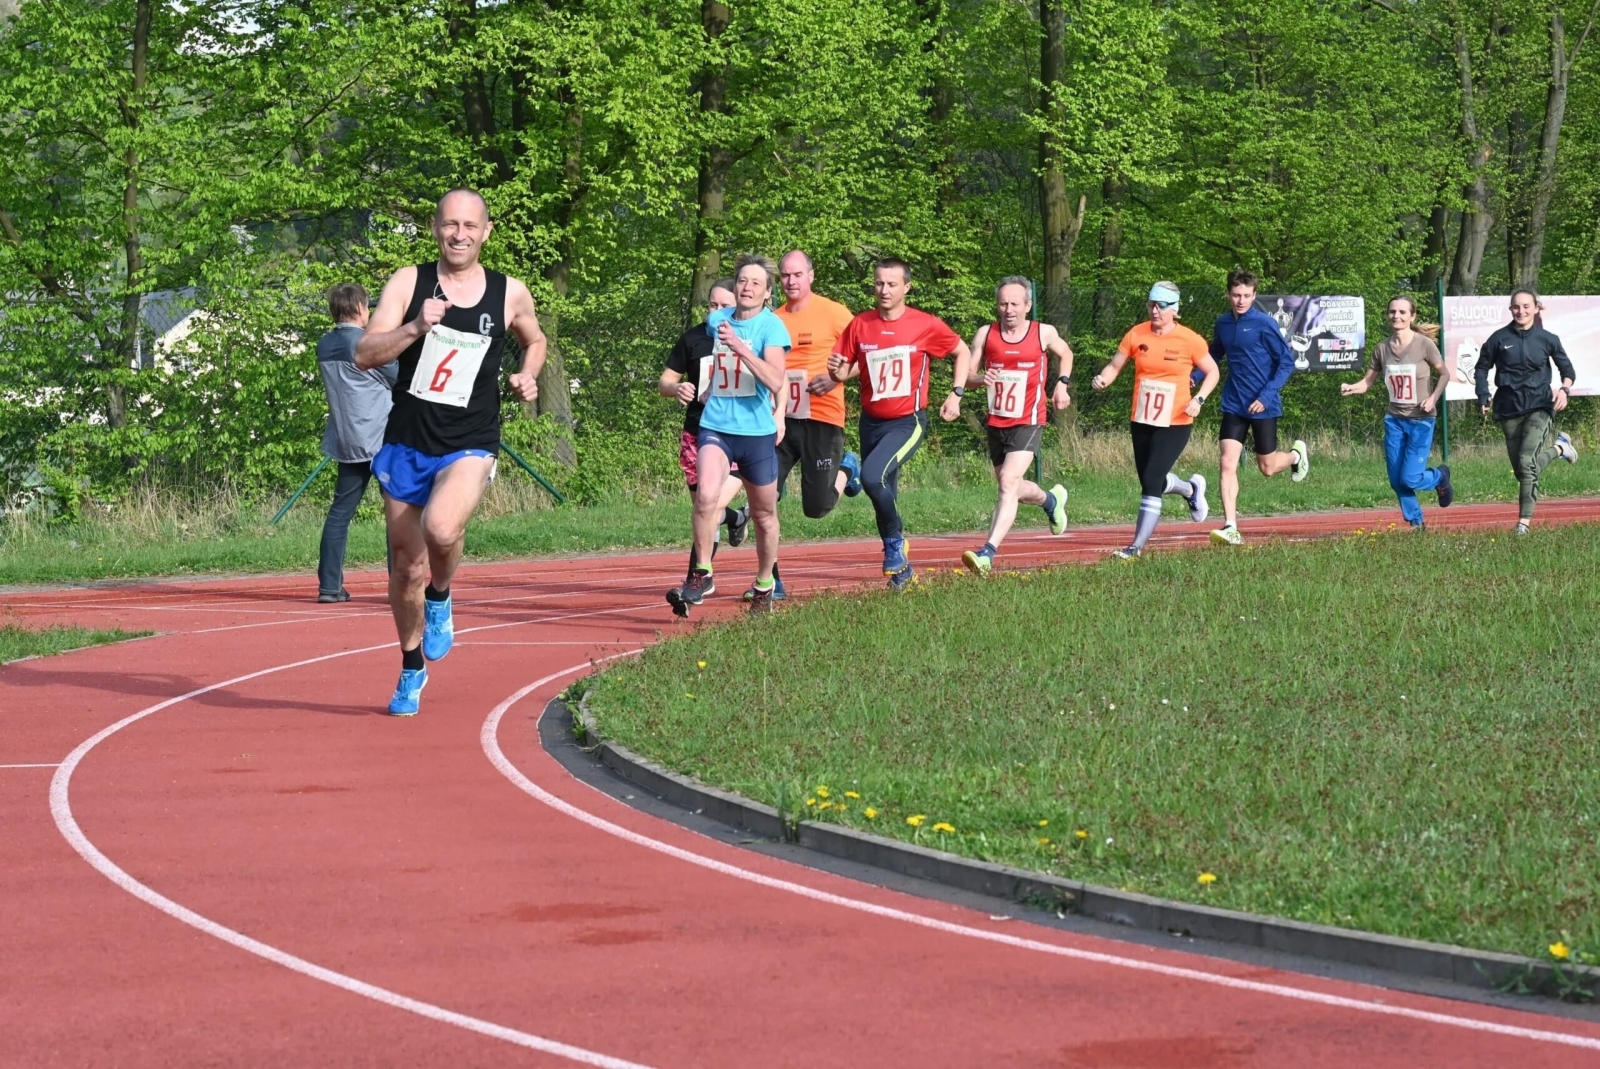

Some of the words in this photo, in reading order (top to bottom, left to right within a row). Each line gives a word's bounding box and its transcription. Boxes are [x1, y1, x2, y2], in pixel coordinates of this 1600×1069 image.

[429, 349, 458, 392] 6
[717, 353, 742, 389] 57
[877, 359, 903, 393] 69
[994, 381, 1017, 412] 86
[1389, 375, 1413, 400] 183
[1144, 391, 1166, 421] 19
